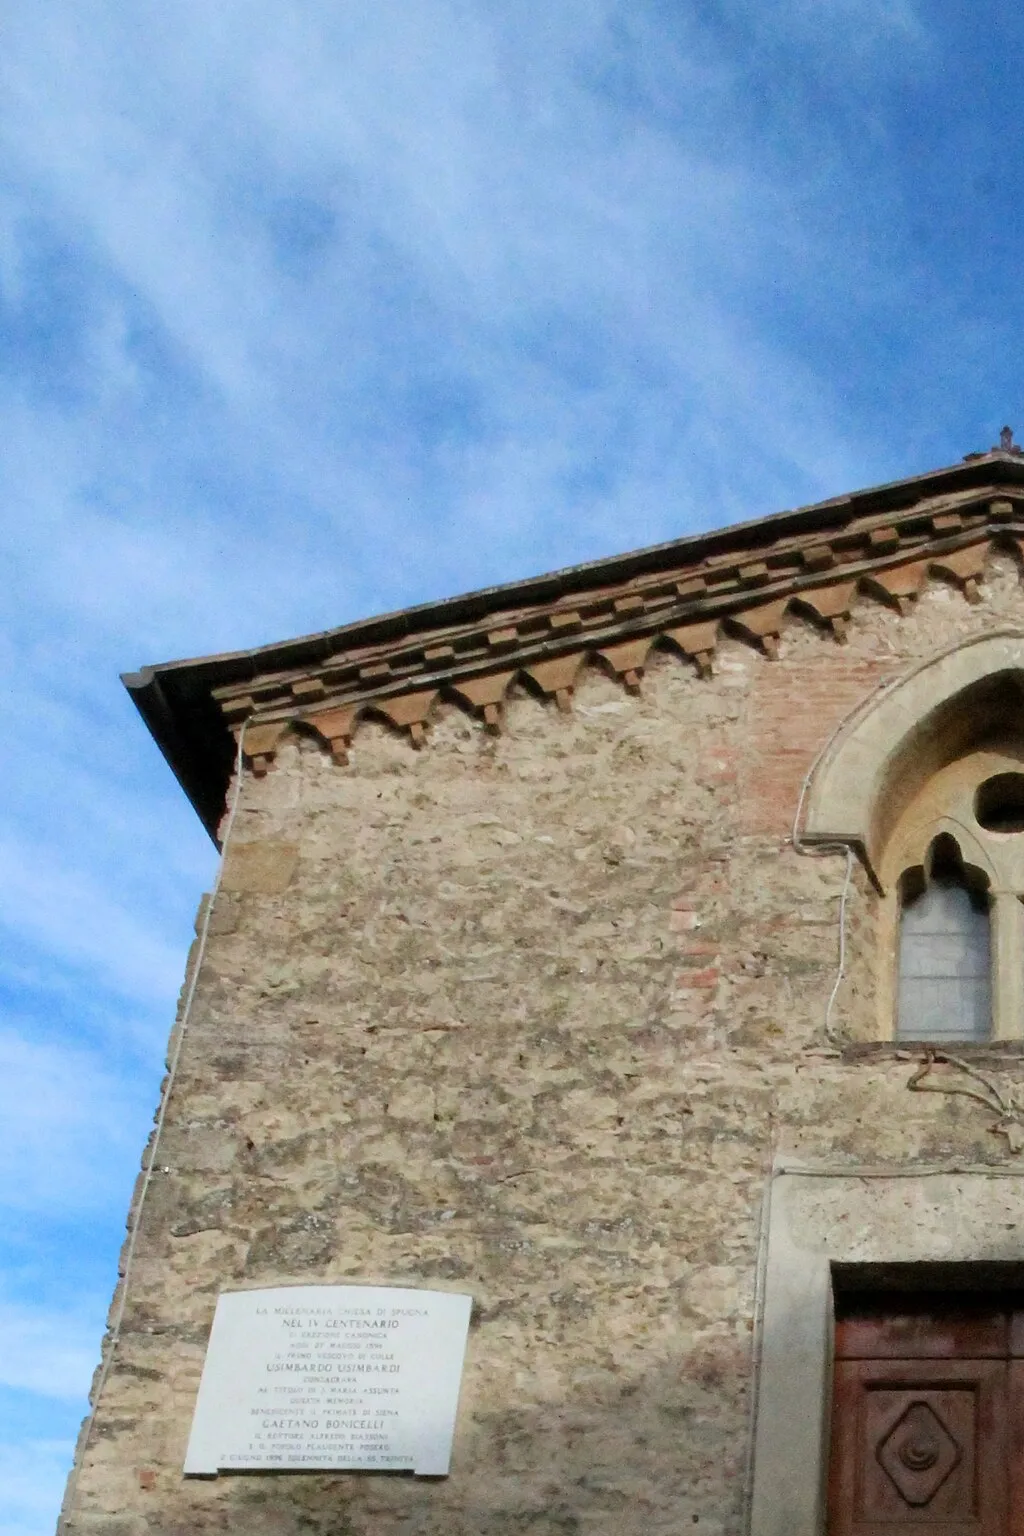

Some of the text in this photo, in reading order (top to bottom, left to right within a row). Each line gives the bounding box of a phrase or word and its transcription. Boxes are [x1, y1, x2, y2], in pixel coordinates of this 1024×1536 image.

[325, 1320, 400, 1328] CENTENARIO
[266, 1364, 400, 1372] USIMBARDO USIMBARDI
[262, 1420, 384, 1429] GAETANO BONICELLI
